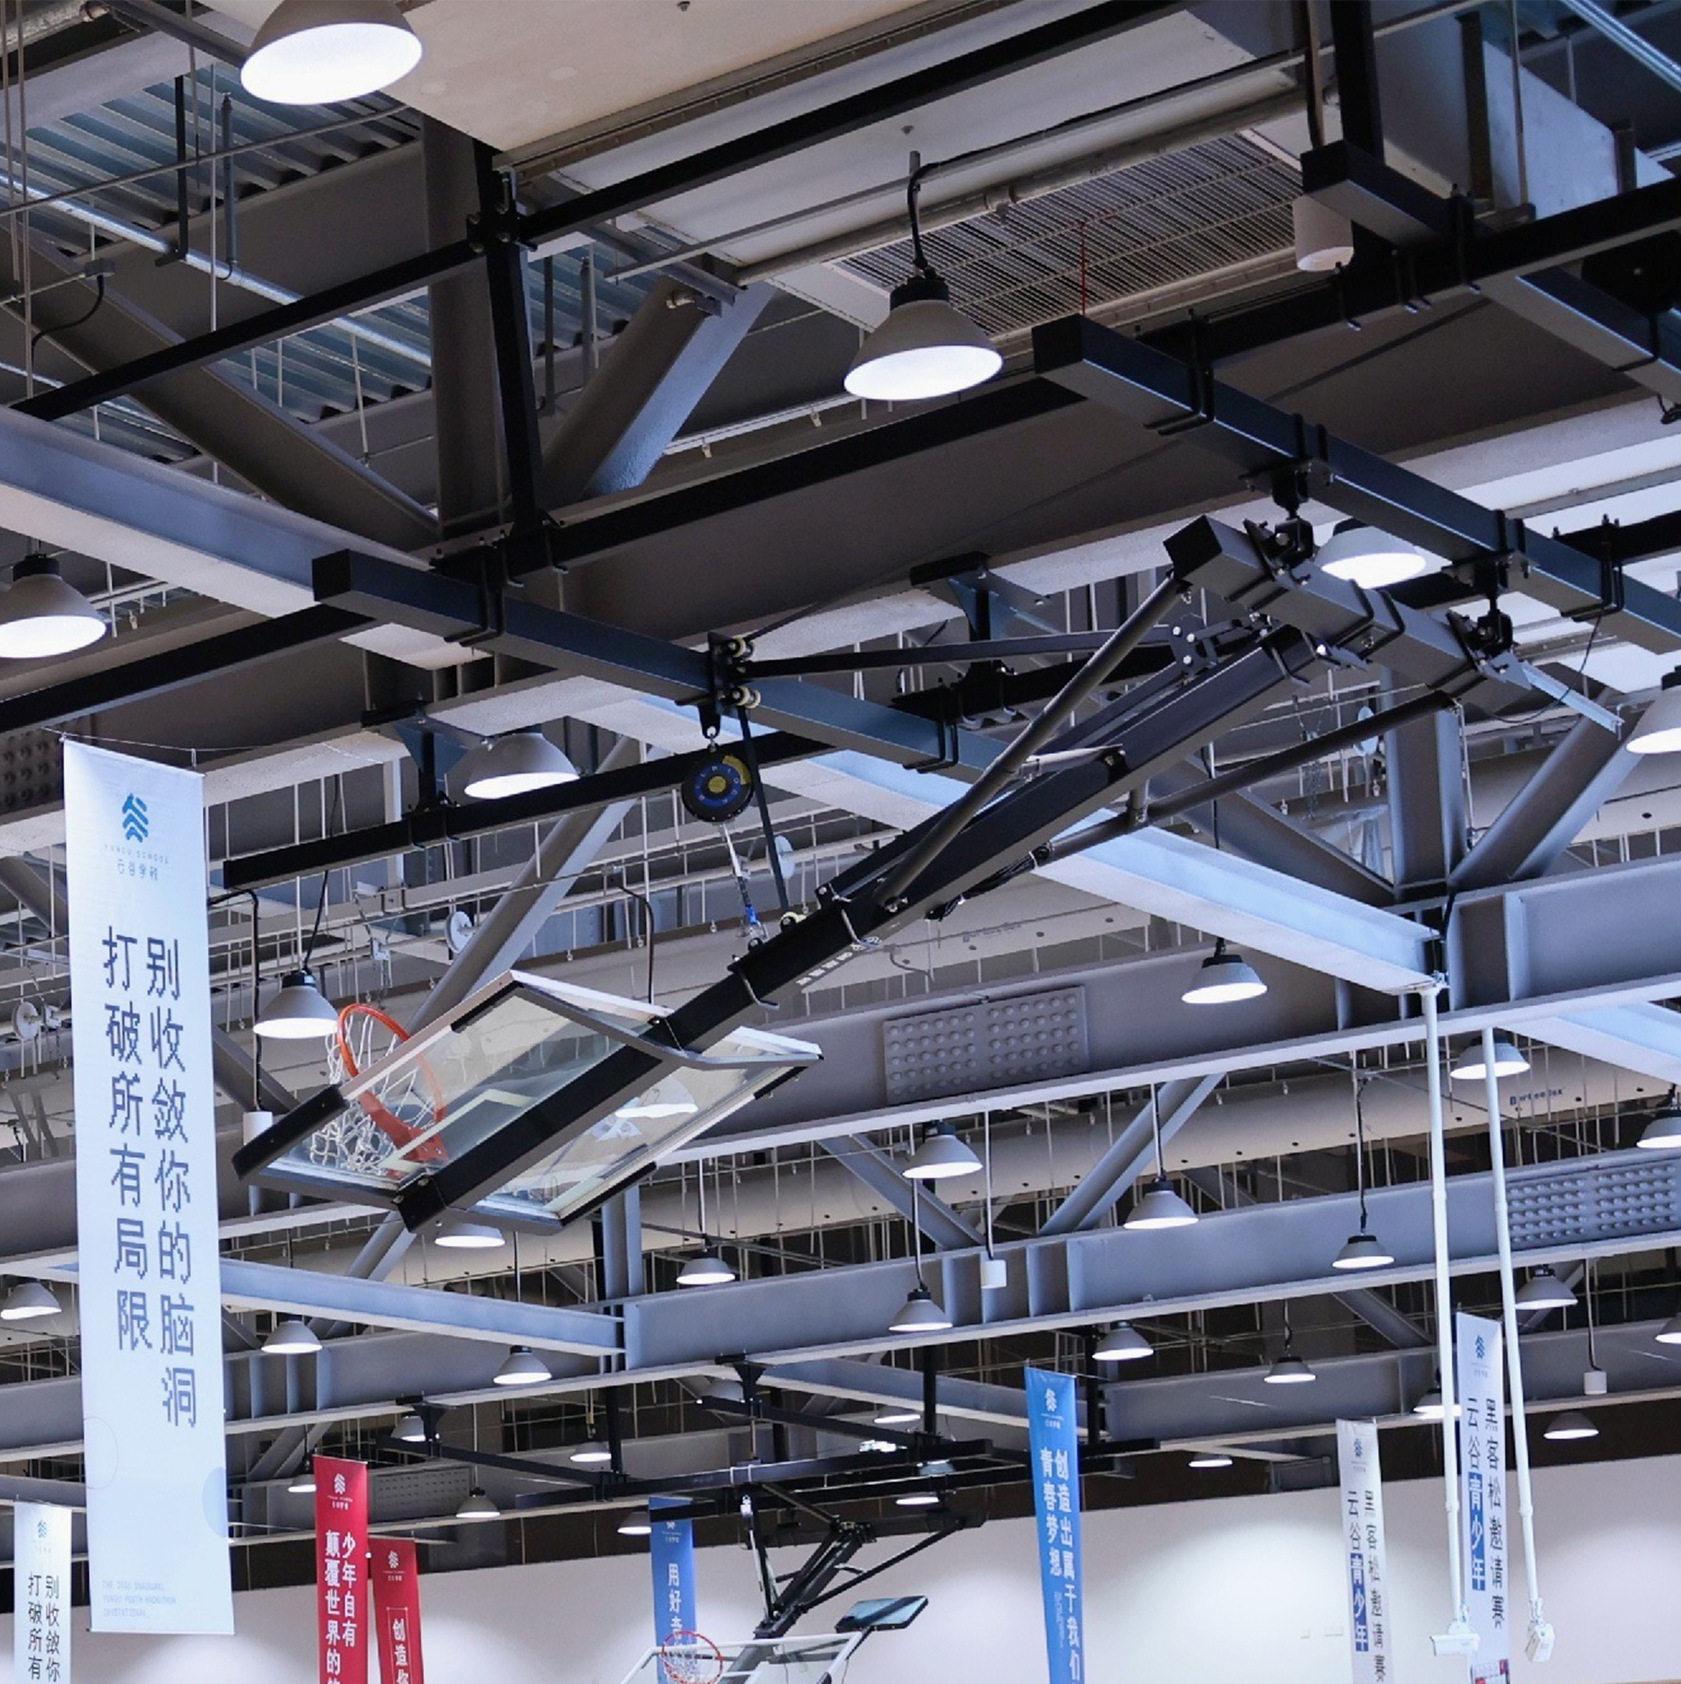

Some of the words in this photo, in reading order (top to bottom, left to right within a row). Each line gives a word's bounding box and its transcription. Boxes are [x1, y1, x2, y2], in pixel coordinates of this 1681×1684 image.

[102, 925, 153, 1351] 打破所有局限
[146, 936, 197, 1428] 别收敛你的脑洞
[342, 1531, 357, 1647] 少年自有
